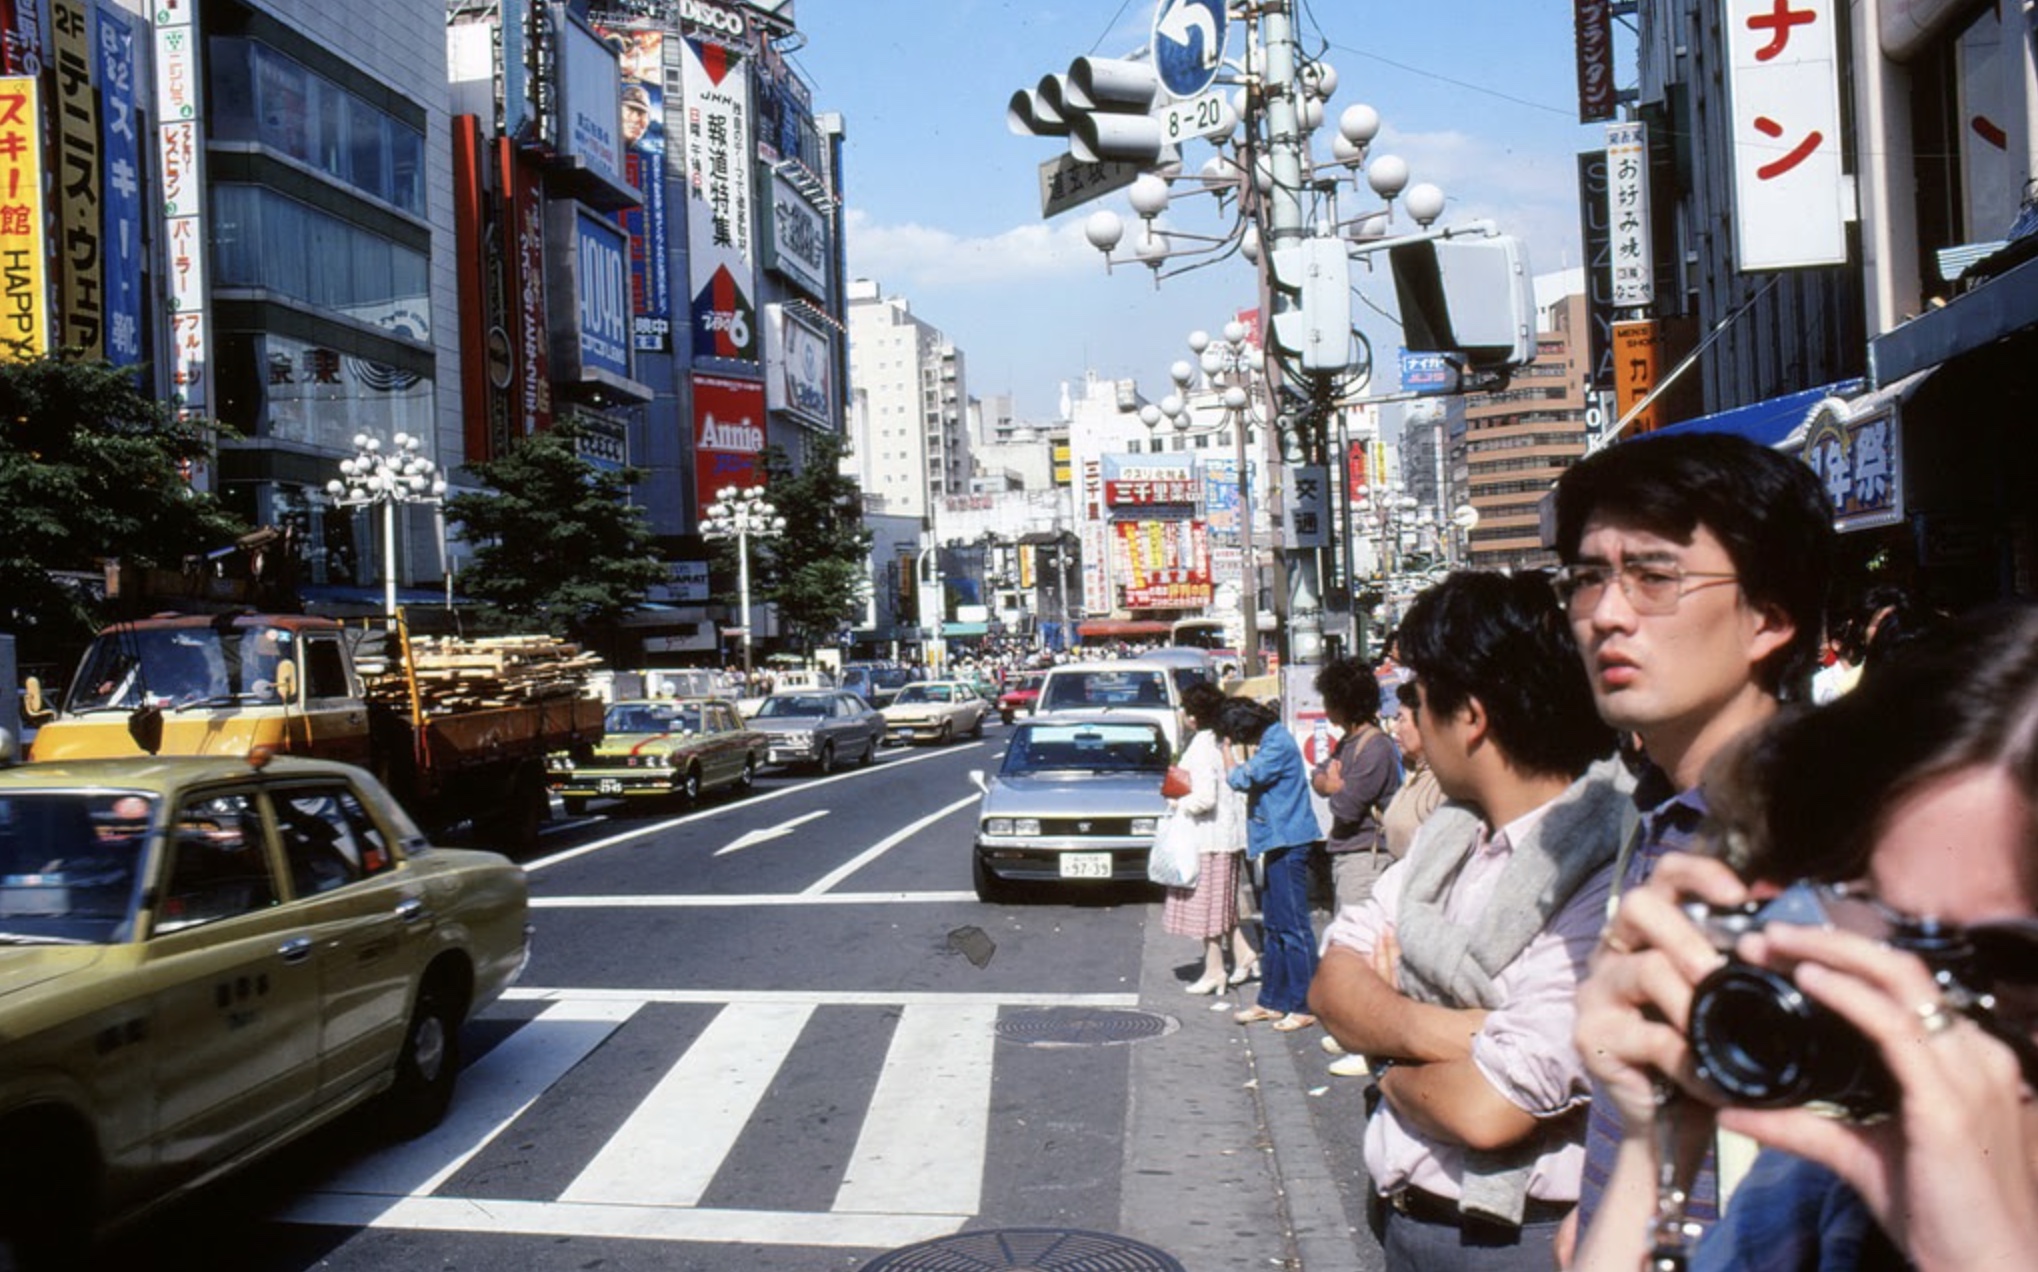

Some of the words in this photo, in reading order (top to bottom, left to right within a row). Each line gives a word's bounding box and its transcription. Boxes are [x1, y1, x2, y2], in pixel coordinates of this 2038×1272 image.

[55, 4, 85, 39] 2F
[681, 0, 743, 35] DISCO
[1168, 98, 1221, 137] 8-20
[0, 94, 31, 236] スキー館
[165, 127, 180, 199] レストラン
[1618, 158, 1640, 259] お好み焼
[174, 220, 190, 292] パーラー
[172, 317, 186, 385] ケーキ
[185, 315, 200, 385] フルーツ
[697, 411, 763, 452] Annie
[1085, 461, 1100, 520] 三千里
[1114, 481, 1204, 502] 三千里薬品
[1295, 479, 1318, 535] 交通
